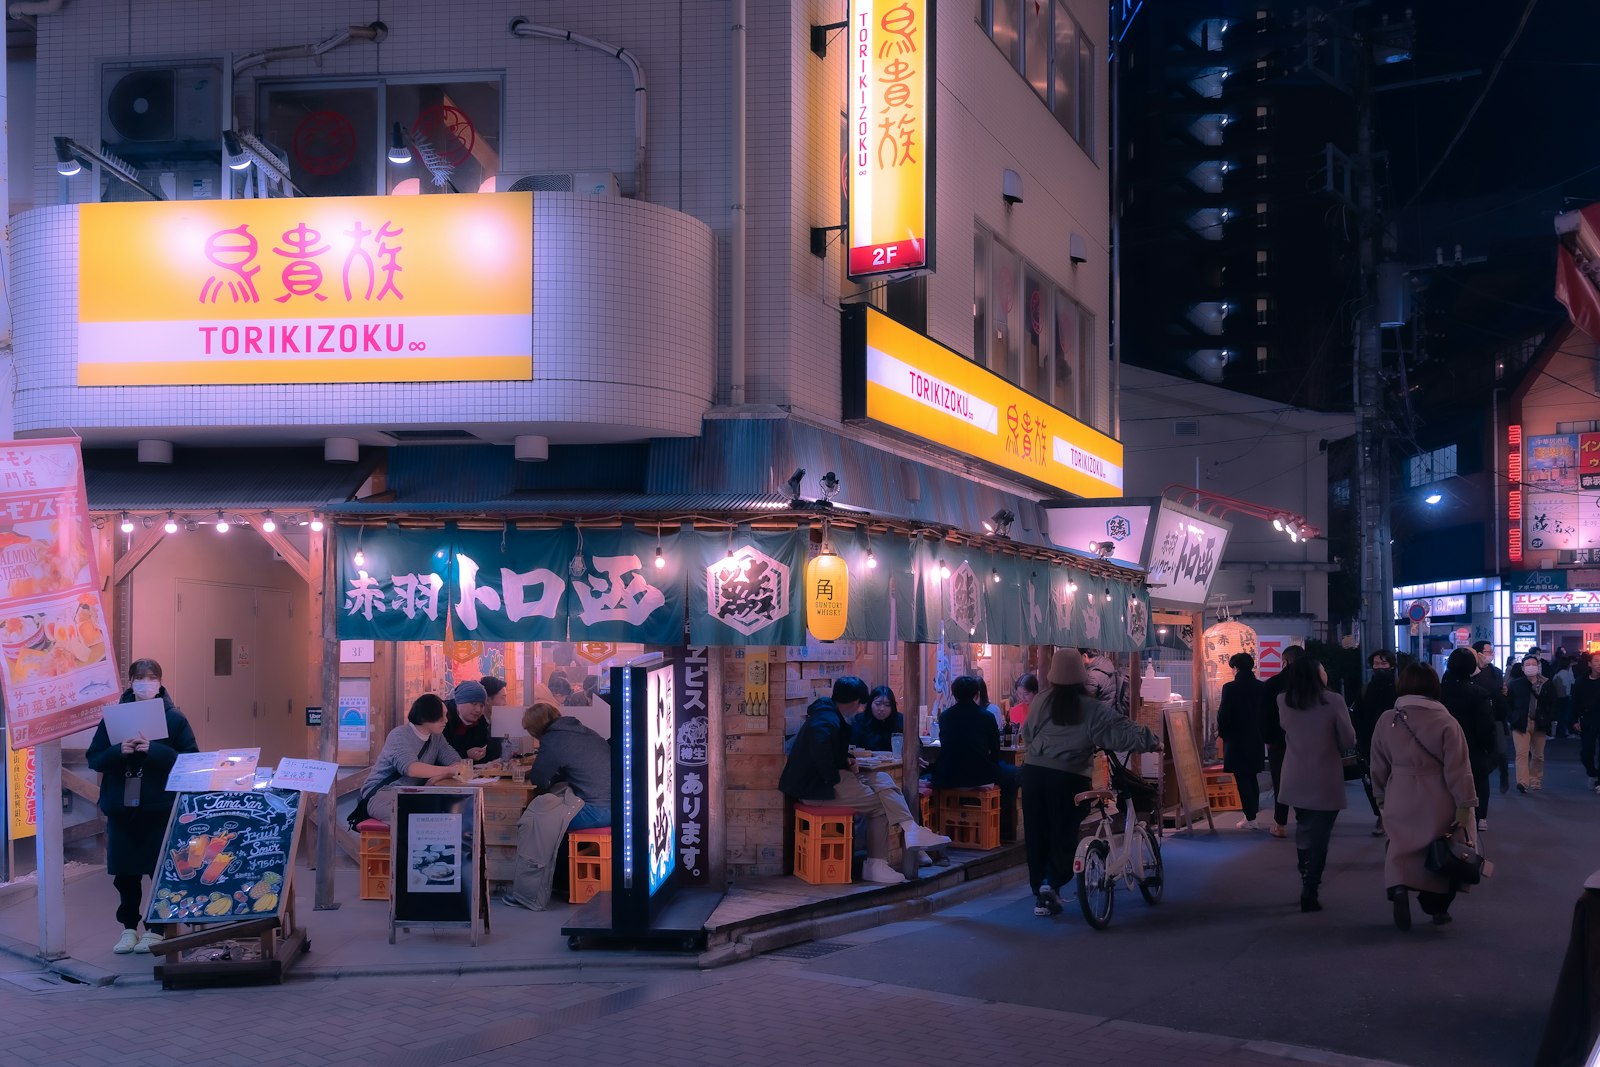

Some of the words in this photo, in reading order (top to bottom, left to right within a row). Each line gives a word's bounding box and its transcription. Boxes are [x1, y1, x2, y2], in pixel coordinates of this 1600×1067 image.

[858, 13, 869, 167] TORIKIZOKU
[872, 246, 898, 265] 2F
[199, 323, 405, 355] TORIKIZOKU
[909, 371, 969, 418] TORIKIZOKU
[1071, 448, 1104, 478] TORIKIZOKU
[815, 578, 833, 600] 角
[15, 727, 28, 741] 3F
[680, 772, 704, 877] あります。
